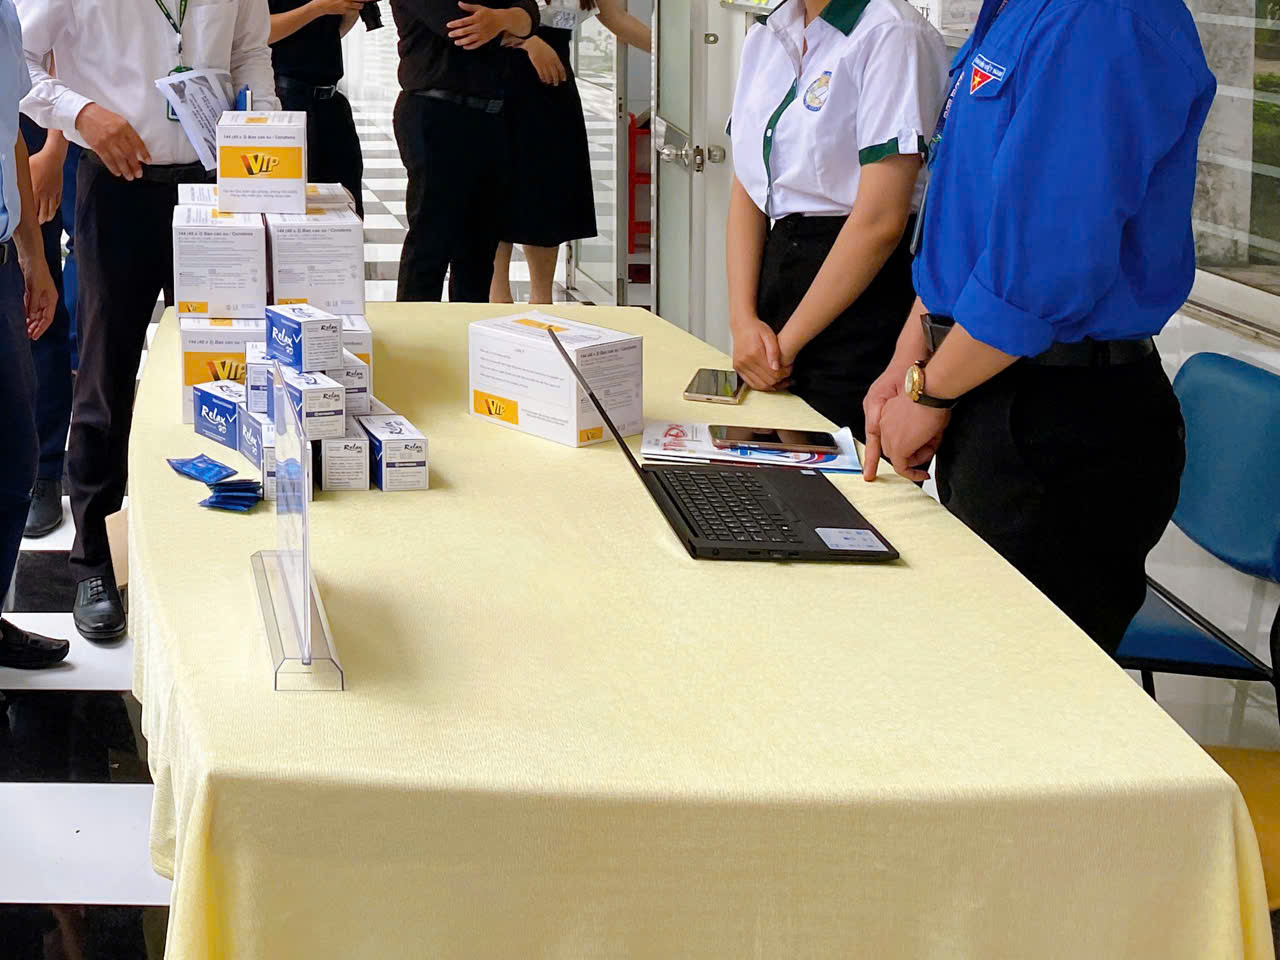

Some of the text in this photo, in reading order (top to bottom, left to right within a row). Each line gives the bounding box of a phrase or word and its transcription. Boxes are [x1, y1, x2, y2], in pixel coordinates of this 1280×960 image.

[241, 152, 280, 176] VIP
[272, 327, 293, 347] Relax
[201, 405, 227, 426] Relax
